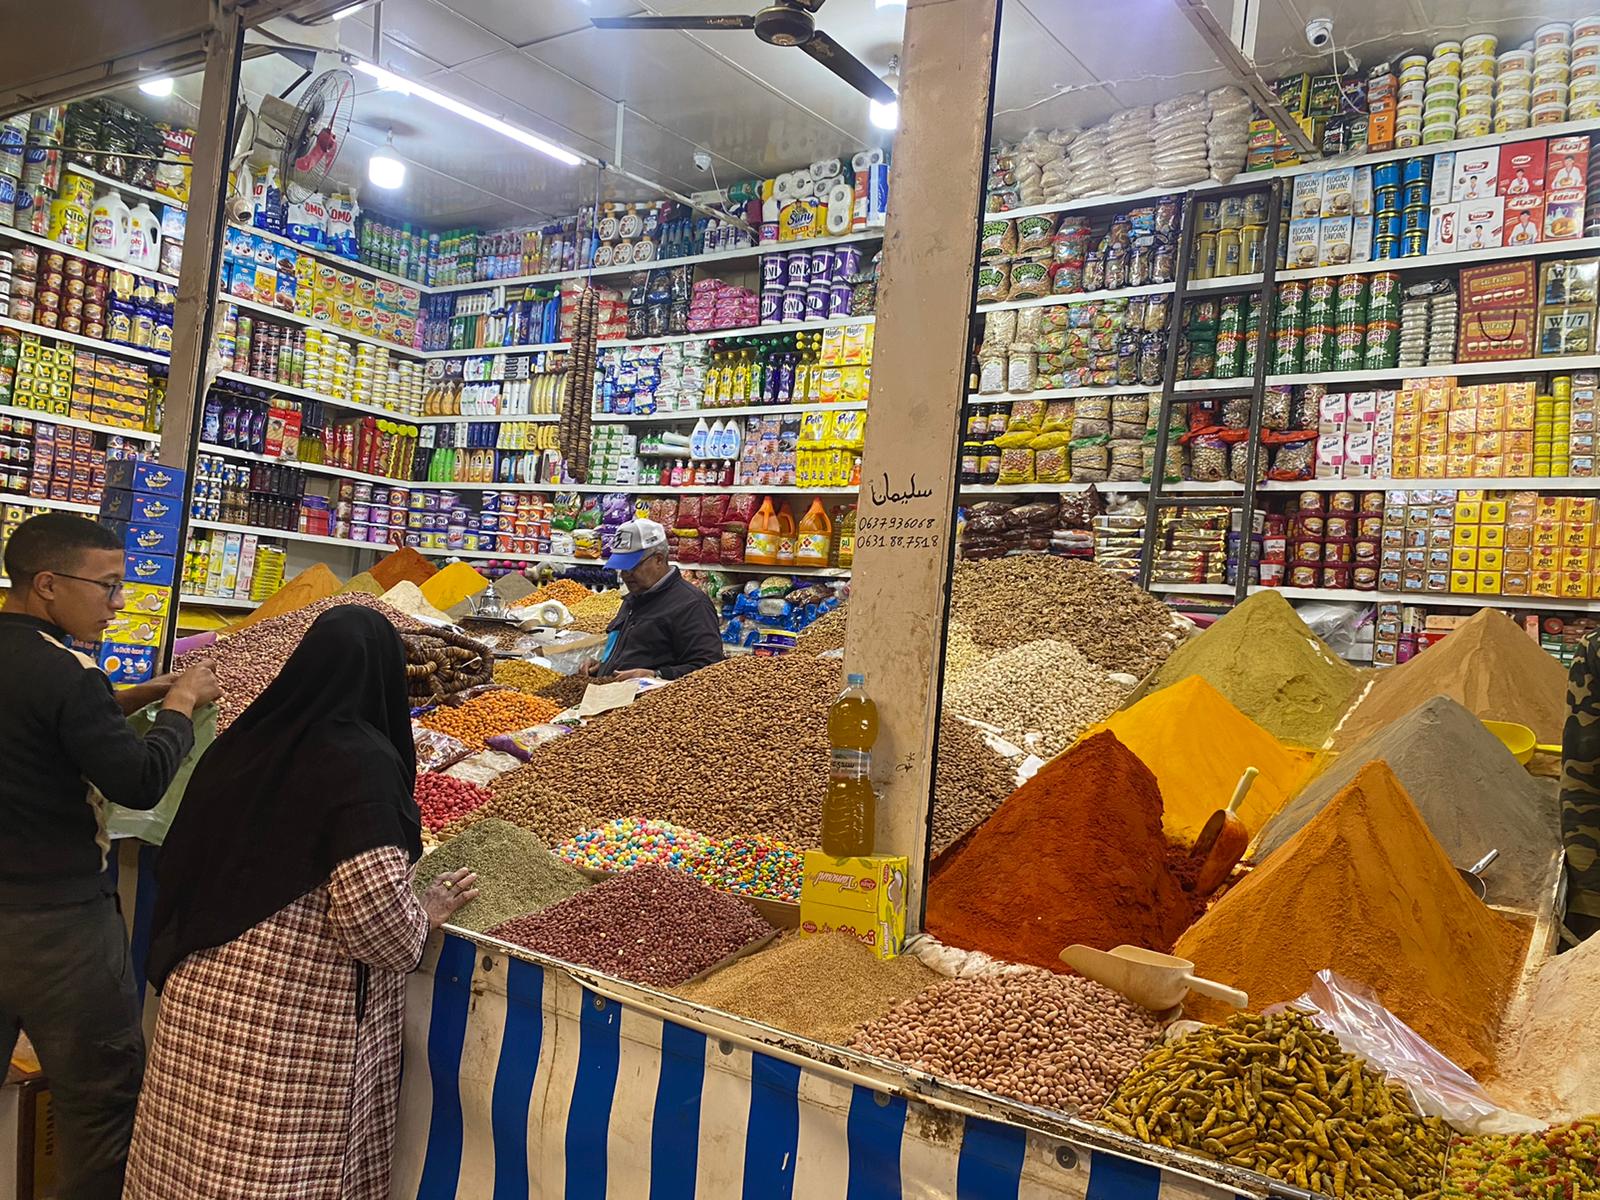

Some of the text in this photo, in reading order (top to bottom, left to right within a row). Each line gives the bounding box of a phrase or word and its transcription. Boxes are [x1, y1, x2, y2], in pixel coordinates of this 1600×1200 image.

[304, 202, 324, 217] OMO
[331, 208, 352, 223] OMO
[868, 472, 933, 507] سليمان
